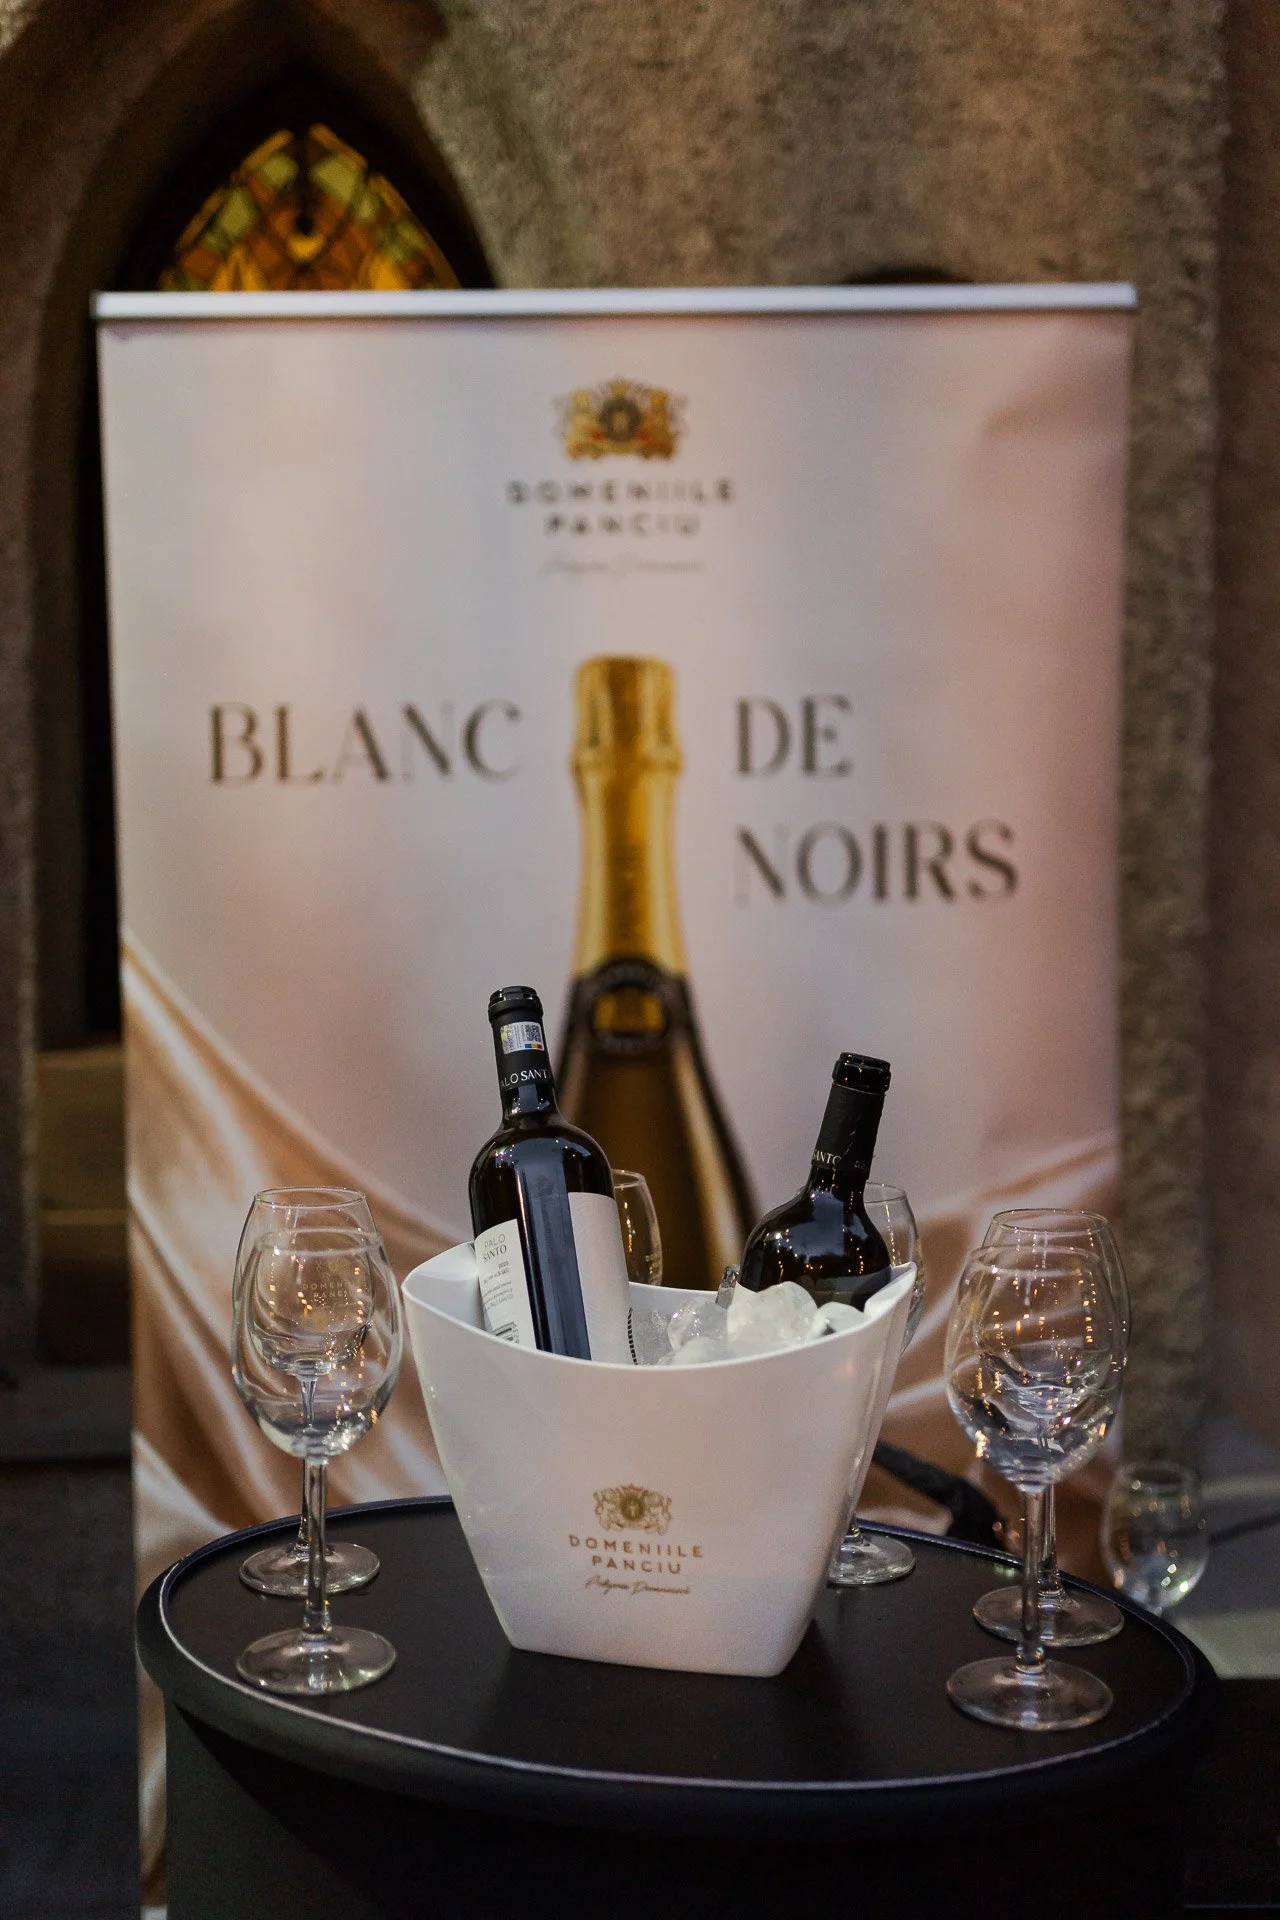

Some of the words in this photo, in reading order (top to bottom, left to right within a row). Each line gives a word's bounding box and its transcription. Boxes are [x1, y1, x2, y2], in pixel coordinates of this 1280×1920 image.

[504, 479, 735, 505] DOMENIILE
[543, 511, 701, 539] PANCIU
[209, 698, 523, 787] BLANC
[734, 695, 853, 778] DE
[733, 818, 1019, 908] NOIRS
[520, 1069, 549, 1082] SANT
[484, 1233, 506, 1249] PALO
[482, 1244, 507, 1263] SANTO
[568, 1534, 704, 1558] DOMENIILE
[591, 1555, 682, 1575] PANCIU
